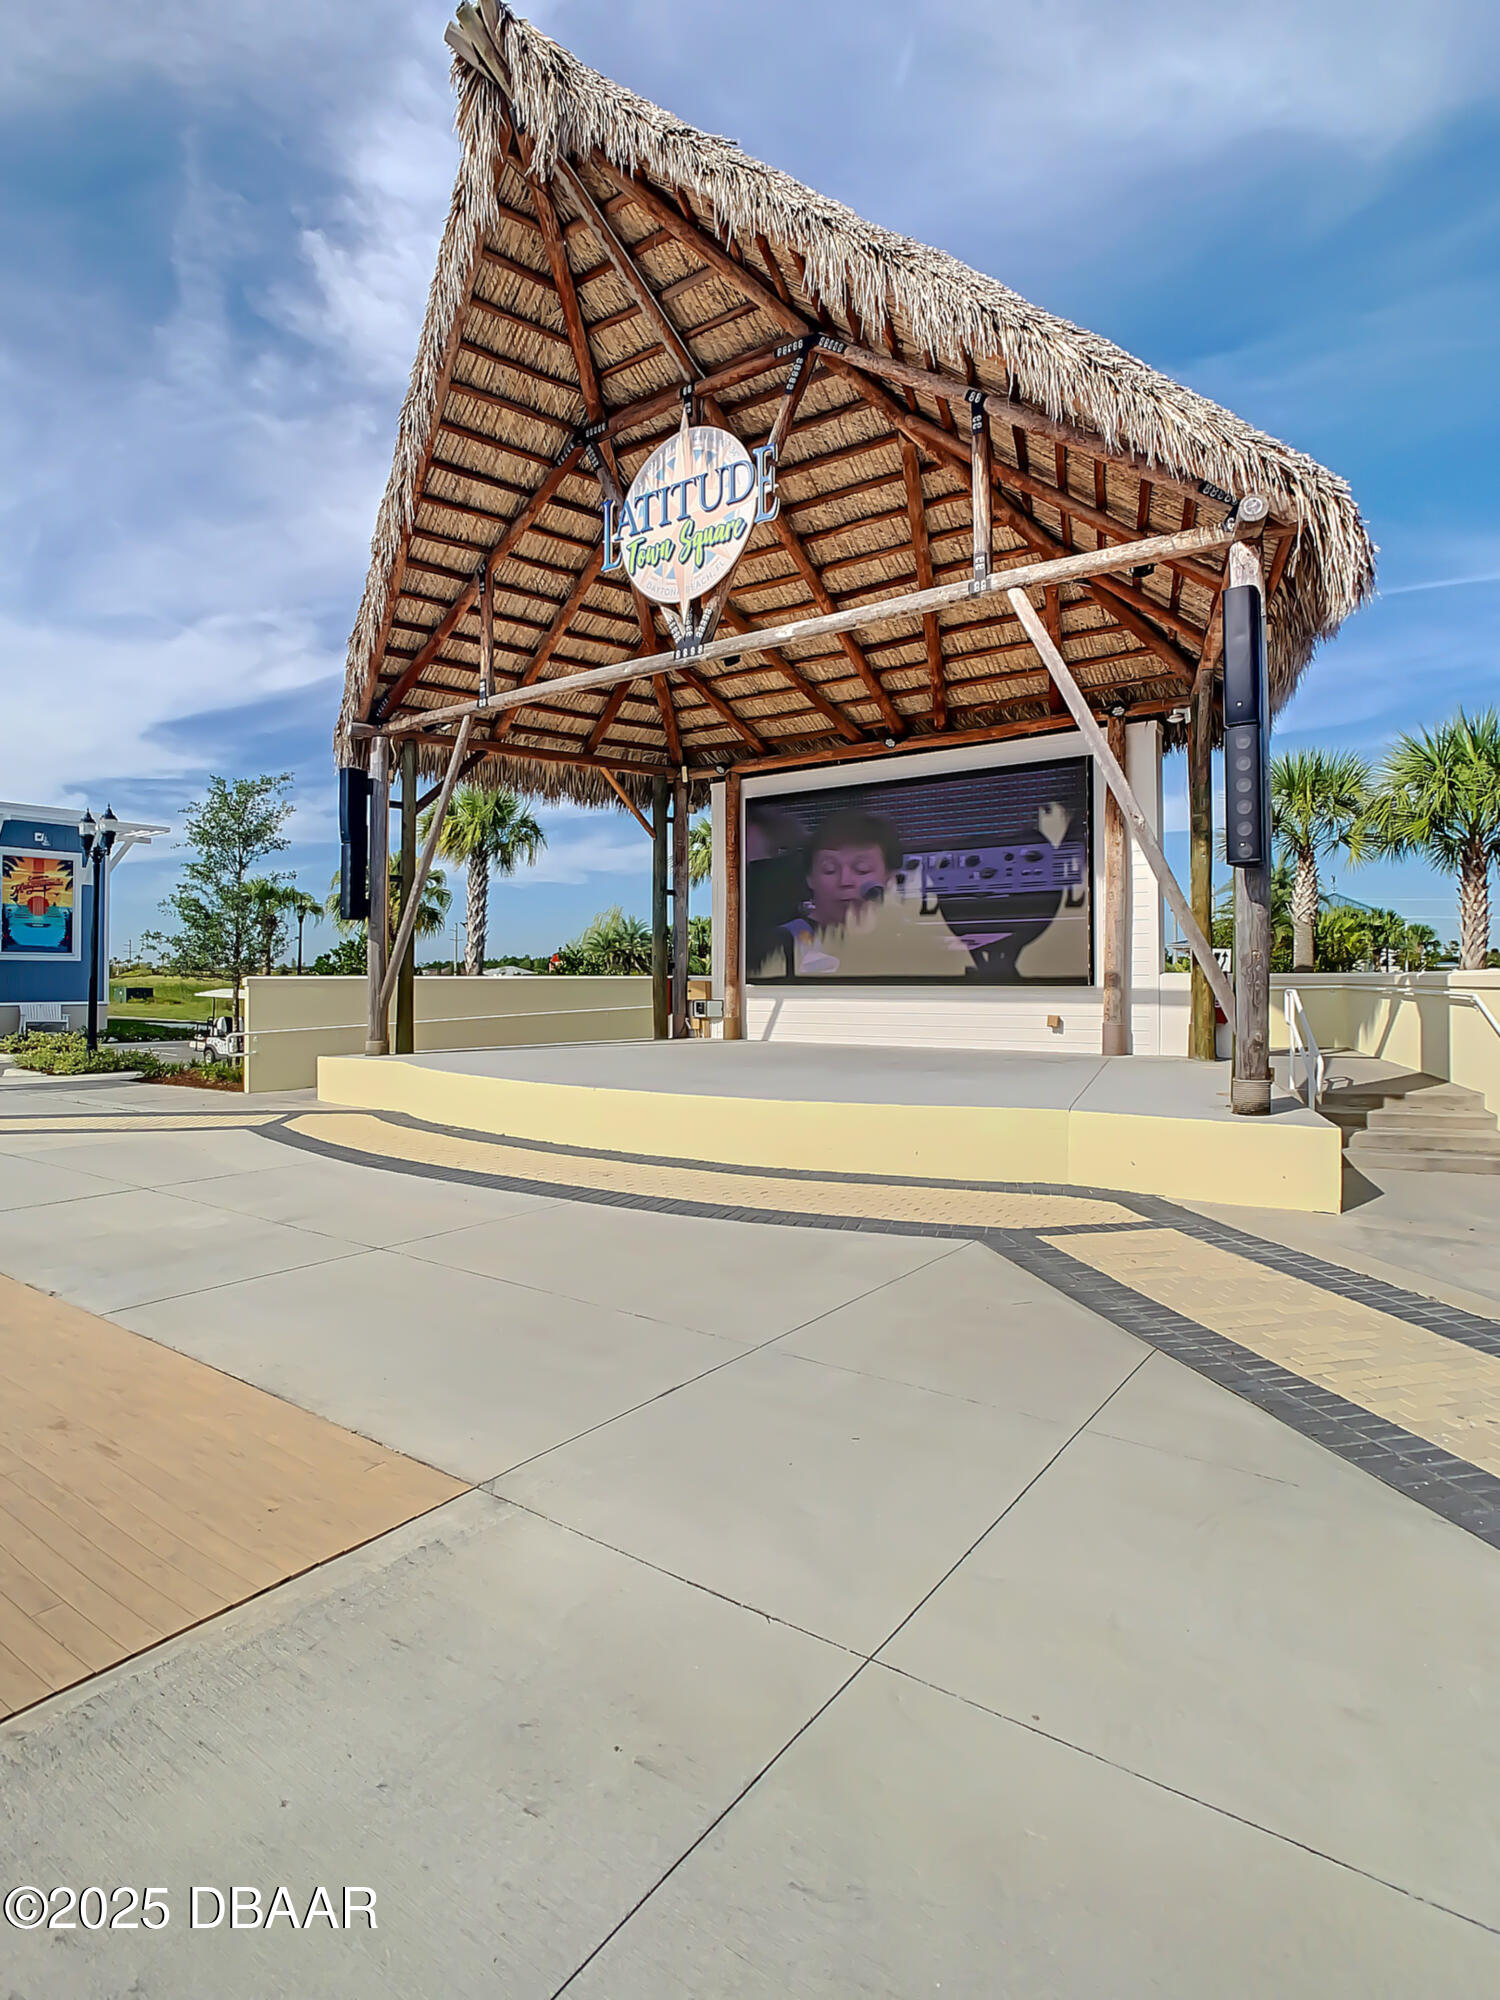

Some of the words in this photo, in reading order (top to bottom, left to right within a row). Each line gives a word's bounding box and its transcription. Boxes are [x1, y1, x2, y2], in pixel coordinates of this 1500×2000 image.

[601, 442, 780, 572] LATITUDE
[626, 537, 676, 577] Town
[678, 518, 748, 568] Square
